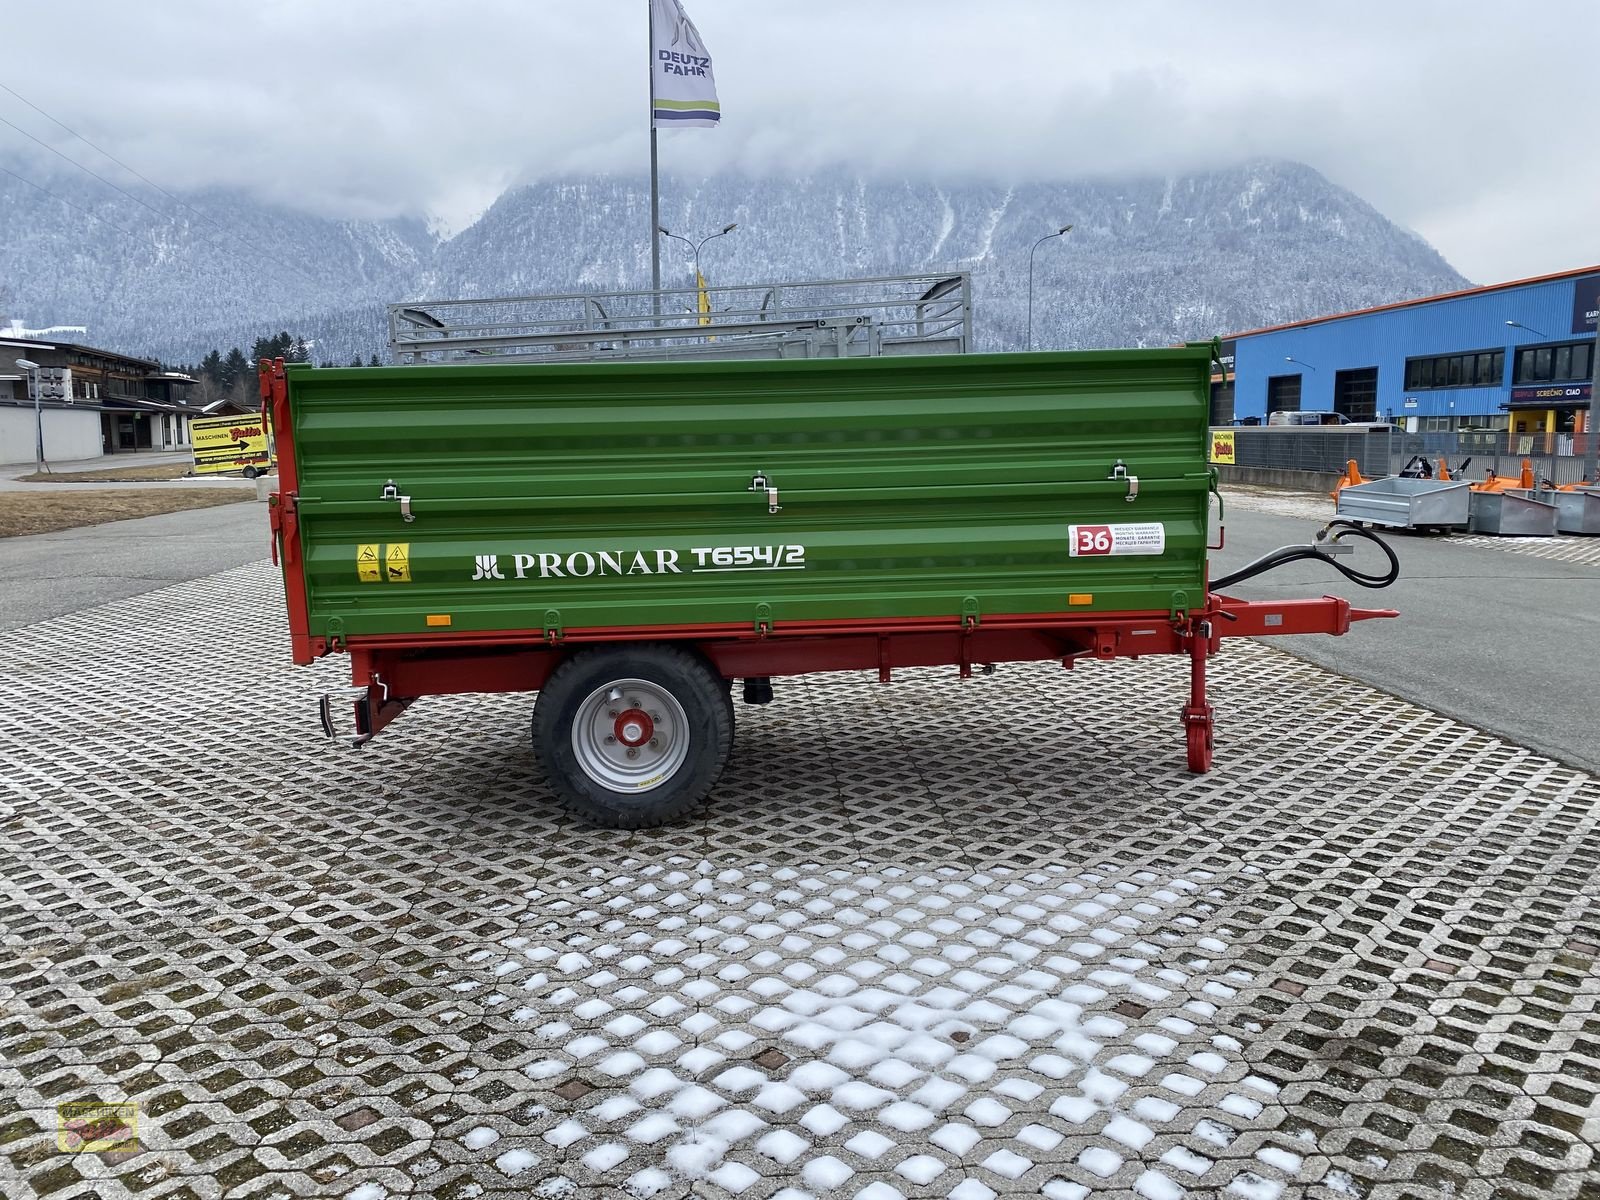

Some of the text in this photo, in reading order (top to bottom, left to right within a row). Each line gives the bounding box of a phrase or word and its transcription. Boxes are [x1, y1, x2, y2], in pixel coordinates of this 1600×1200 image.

[658, 49, 710, 68] DEUTZ
[664, 62, 706, 78] FAHR
[1565, 388, 1581, 396] CIAO
[196, 433, 229, 441] MASCHINEN
[1079, 531, 1110, 551] 36
[511, 545, 806, 579] PRONAR T654/2
